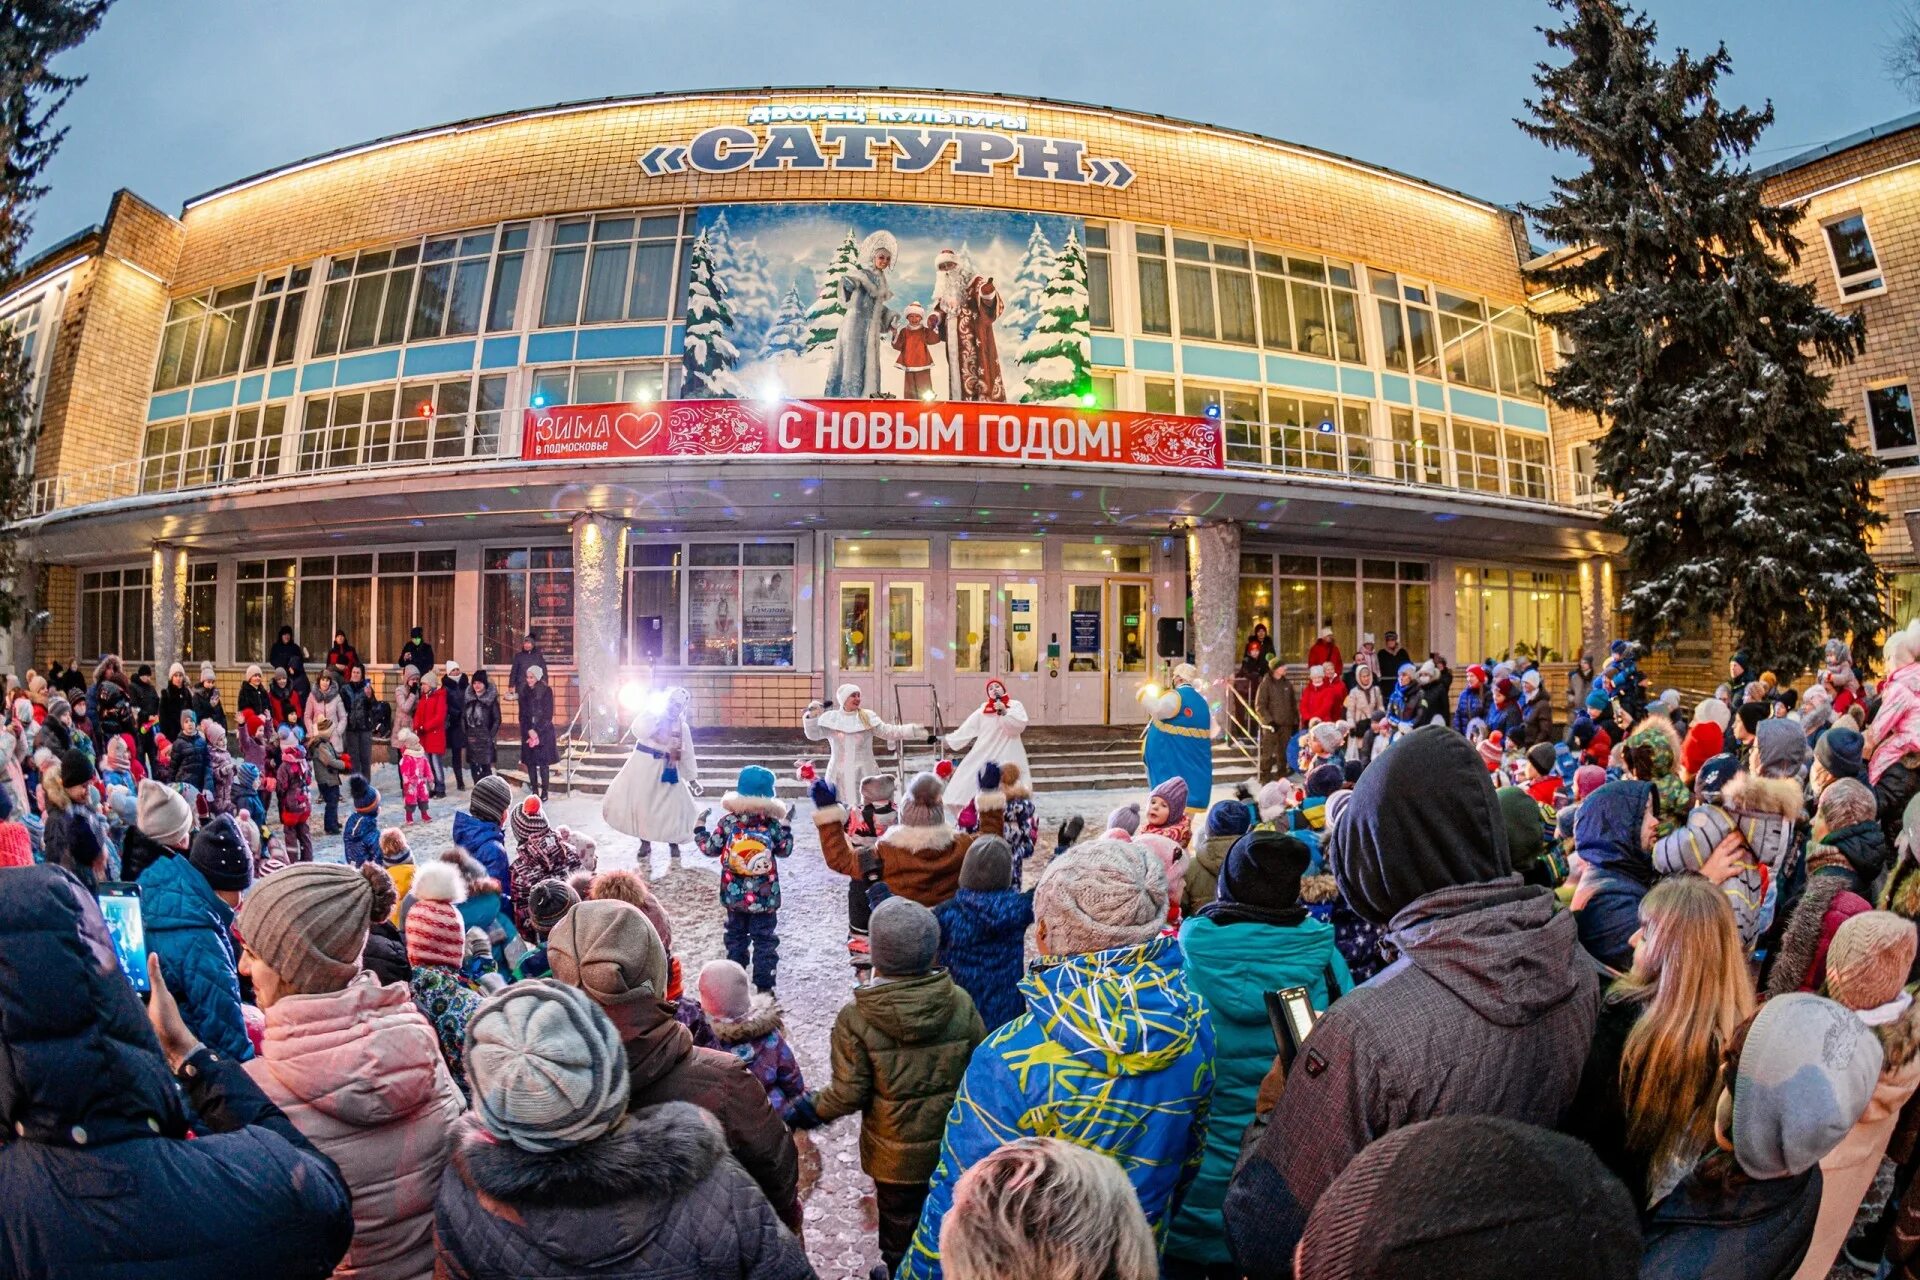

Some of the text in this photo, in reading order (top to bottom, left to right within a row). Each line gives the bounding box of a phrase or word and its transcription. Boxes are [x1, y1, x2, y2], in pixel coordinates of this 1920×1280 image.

[748, 105, 1028, 131] ДВОРЕЦ КУЛЬТУРЫ
[536, 414, 611, 442] ЗИМА
[778, 411, 1122, 460] С НОВЫМ ГОДОМ!
